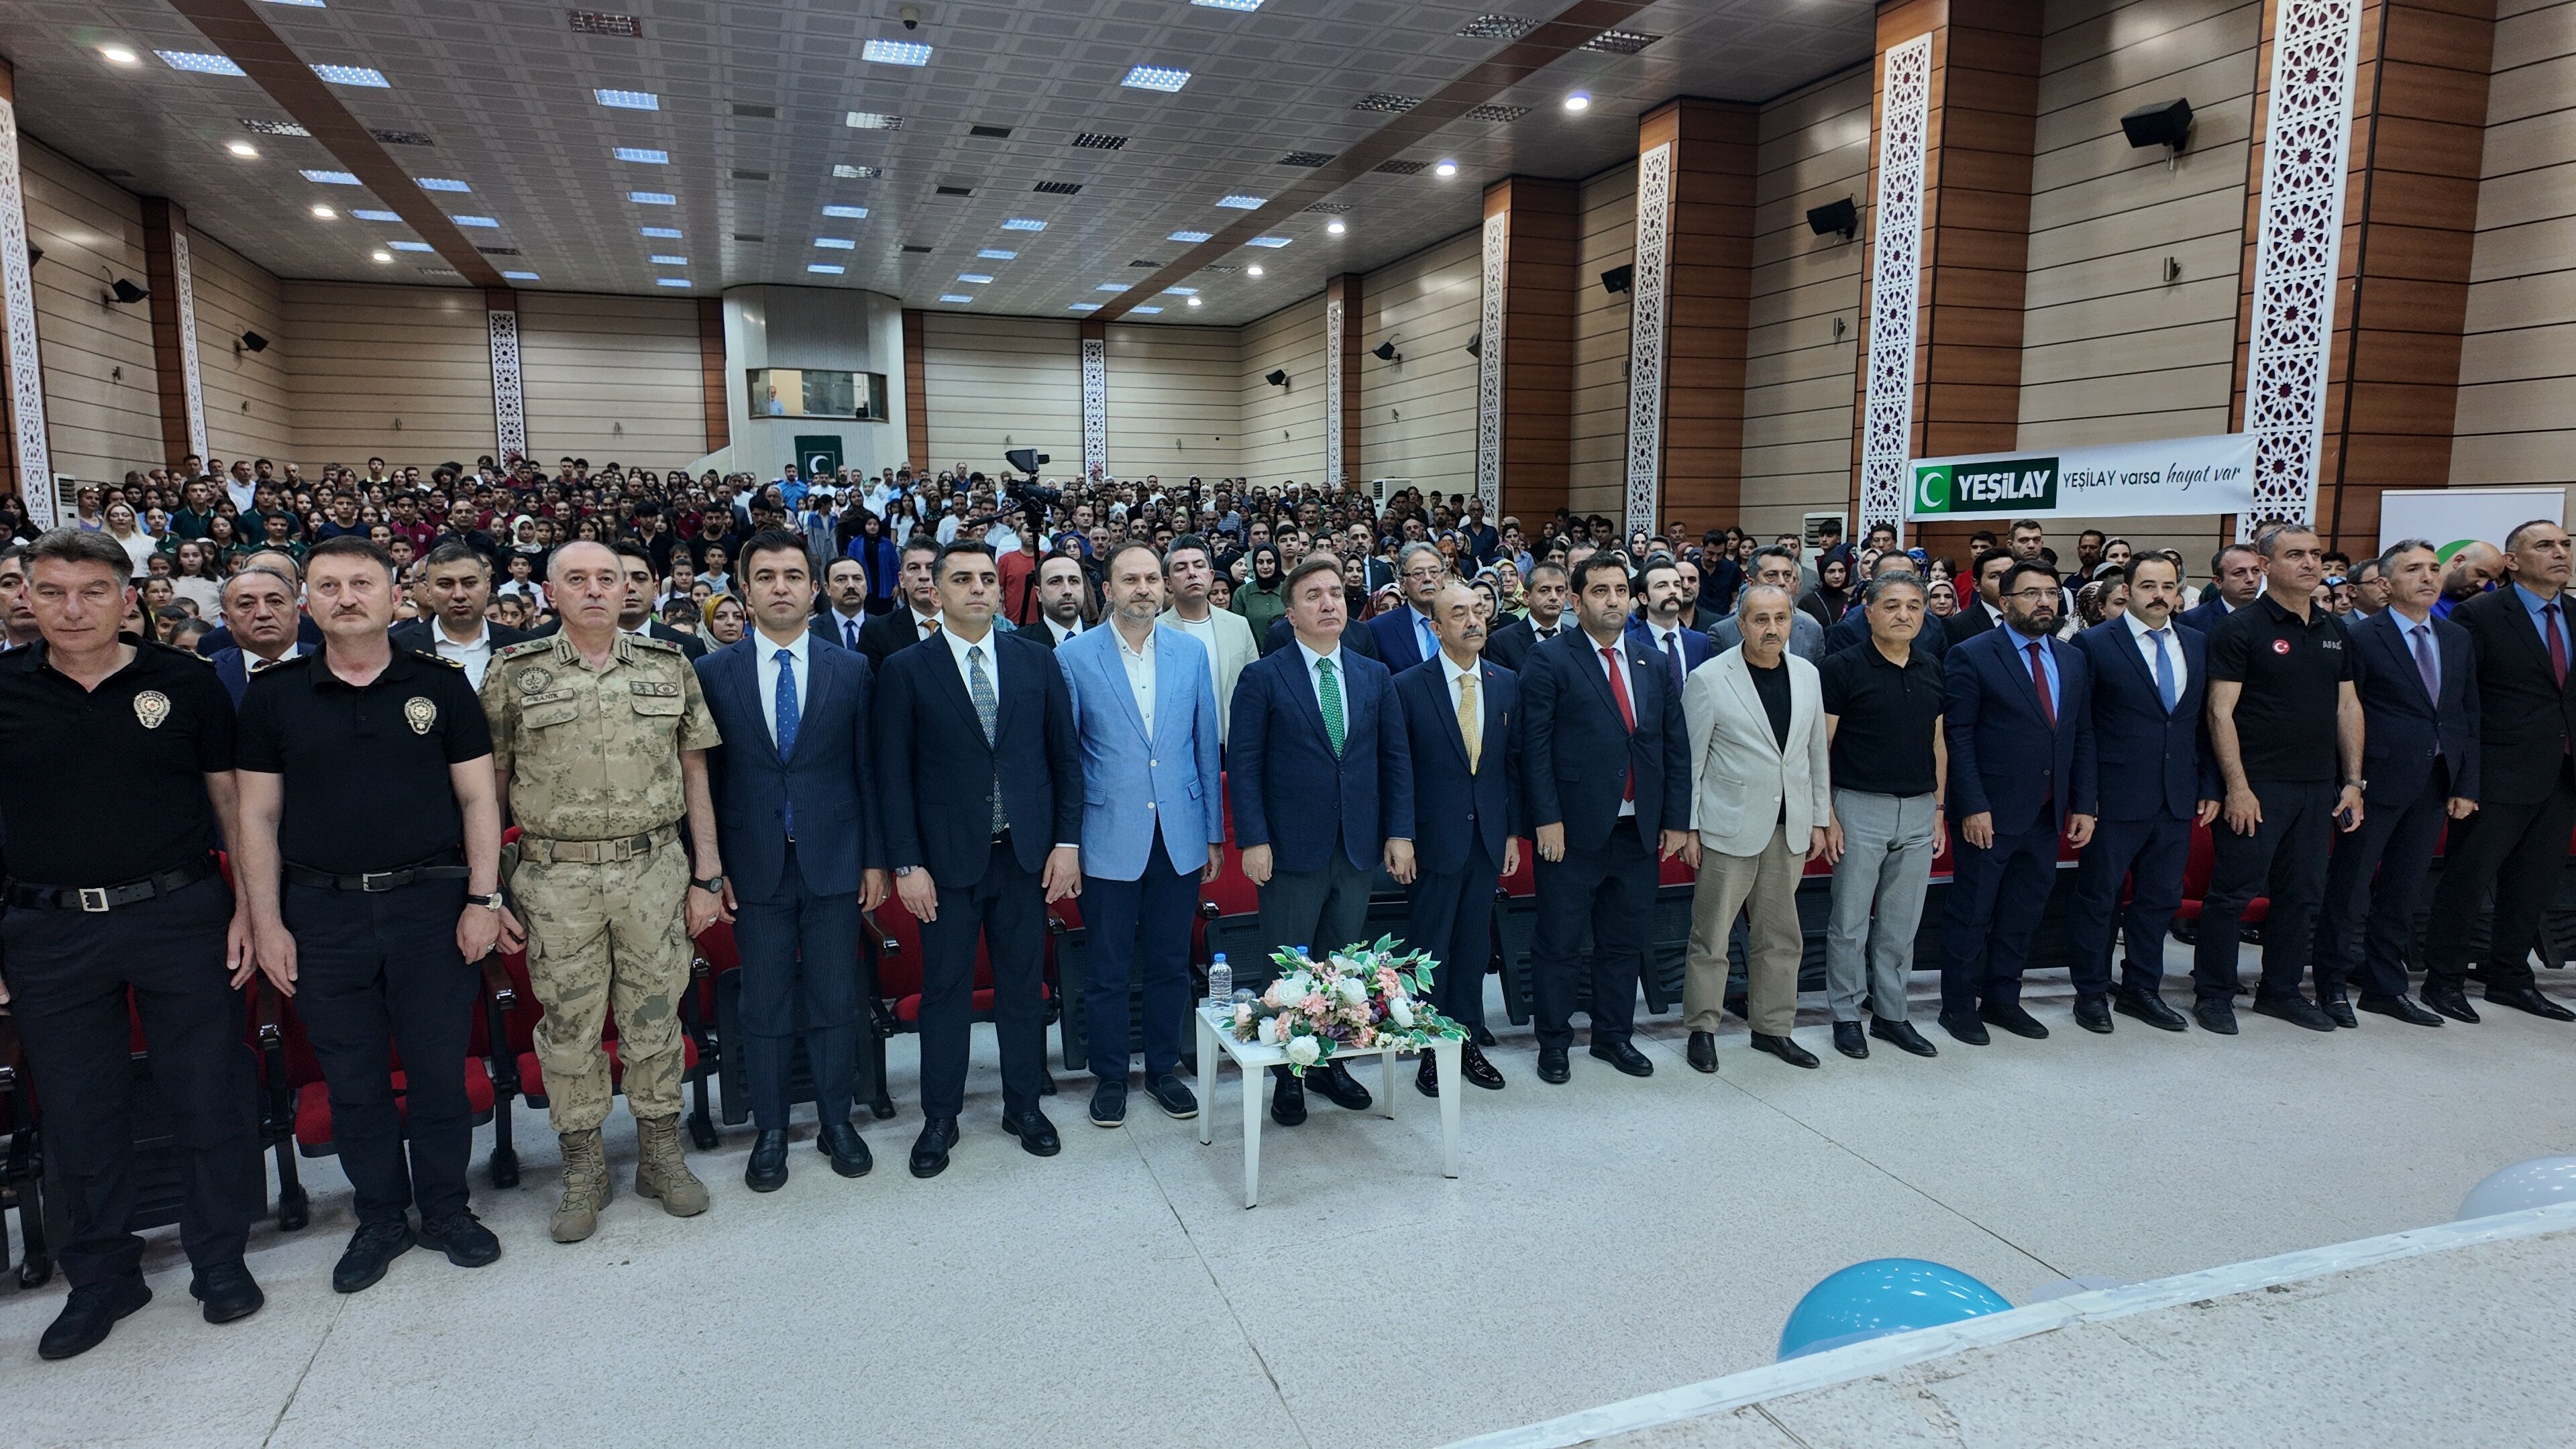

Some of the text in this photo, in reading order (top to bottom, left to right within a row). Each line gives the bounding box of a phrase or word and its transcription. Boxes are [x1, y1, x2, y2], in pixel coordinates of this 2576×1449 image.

[2063, 462, 2241, 492] YEŞİLAY varsa hayat var
